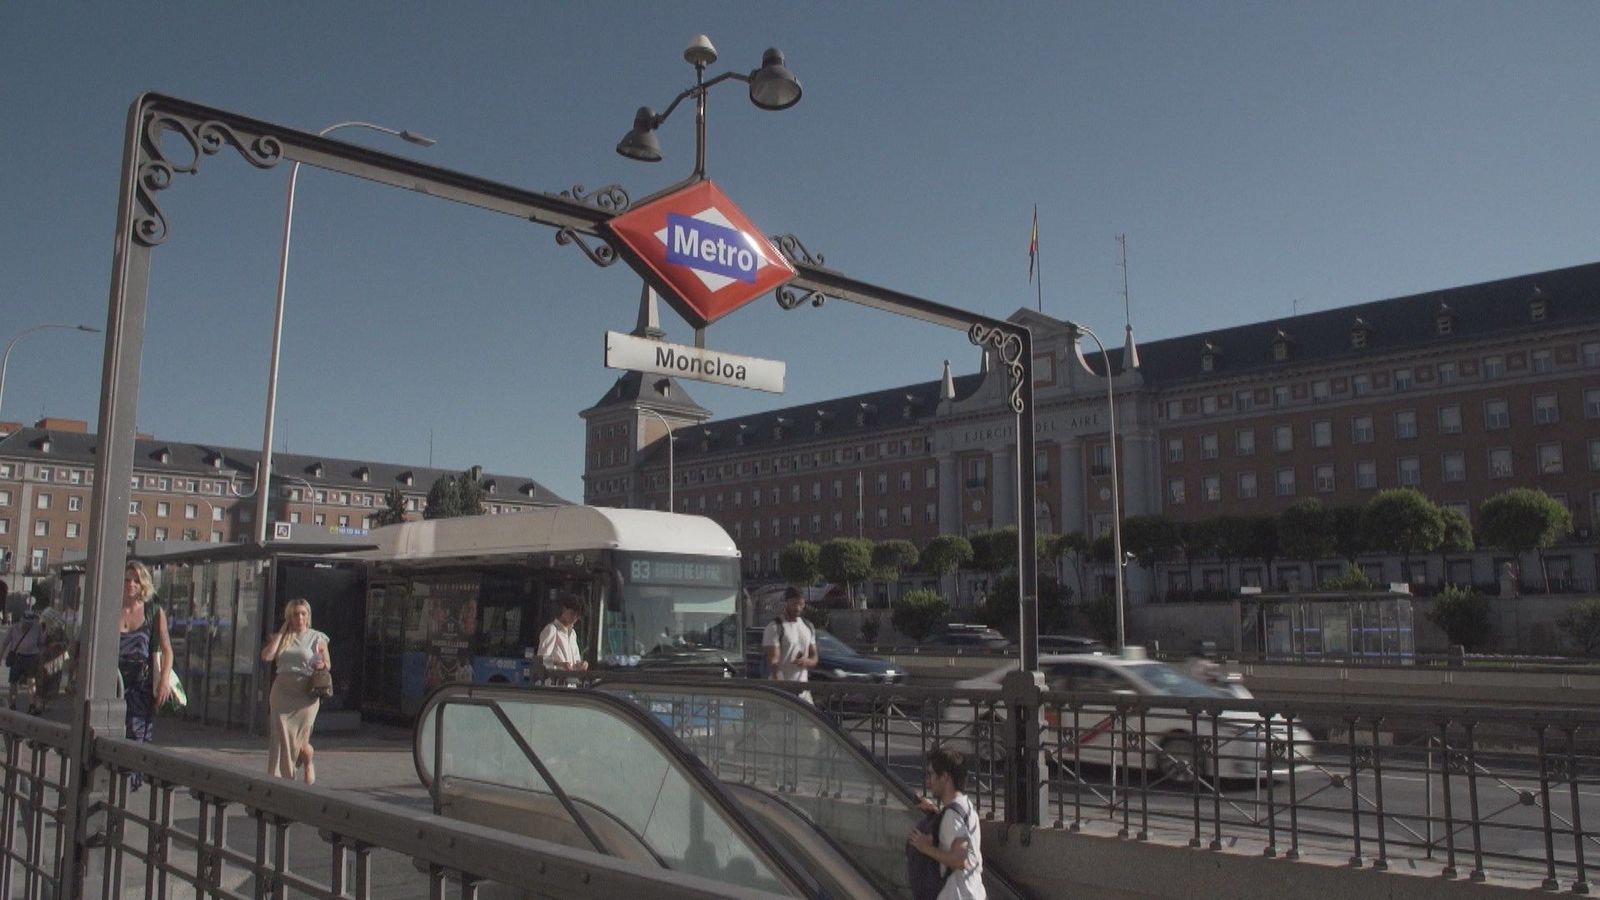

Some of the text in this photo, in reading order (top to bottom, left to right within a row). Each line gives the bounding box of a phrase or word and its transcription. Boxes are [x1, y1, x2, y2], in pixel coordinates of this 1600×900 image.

[674, 225, 753, 271] Metro
[655, 347, 747, 380] Moncloa
[965, 427, 1014, 441] EJERCIT
[1071, 414, 1099, 428] AIRE
[632, 560, 650, 579] 83
